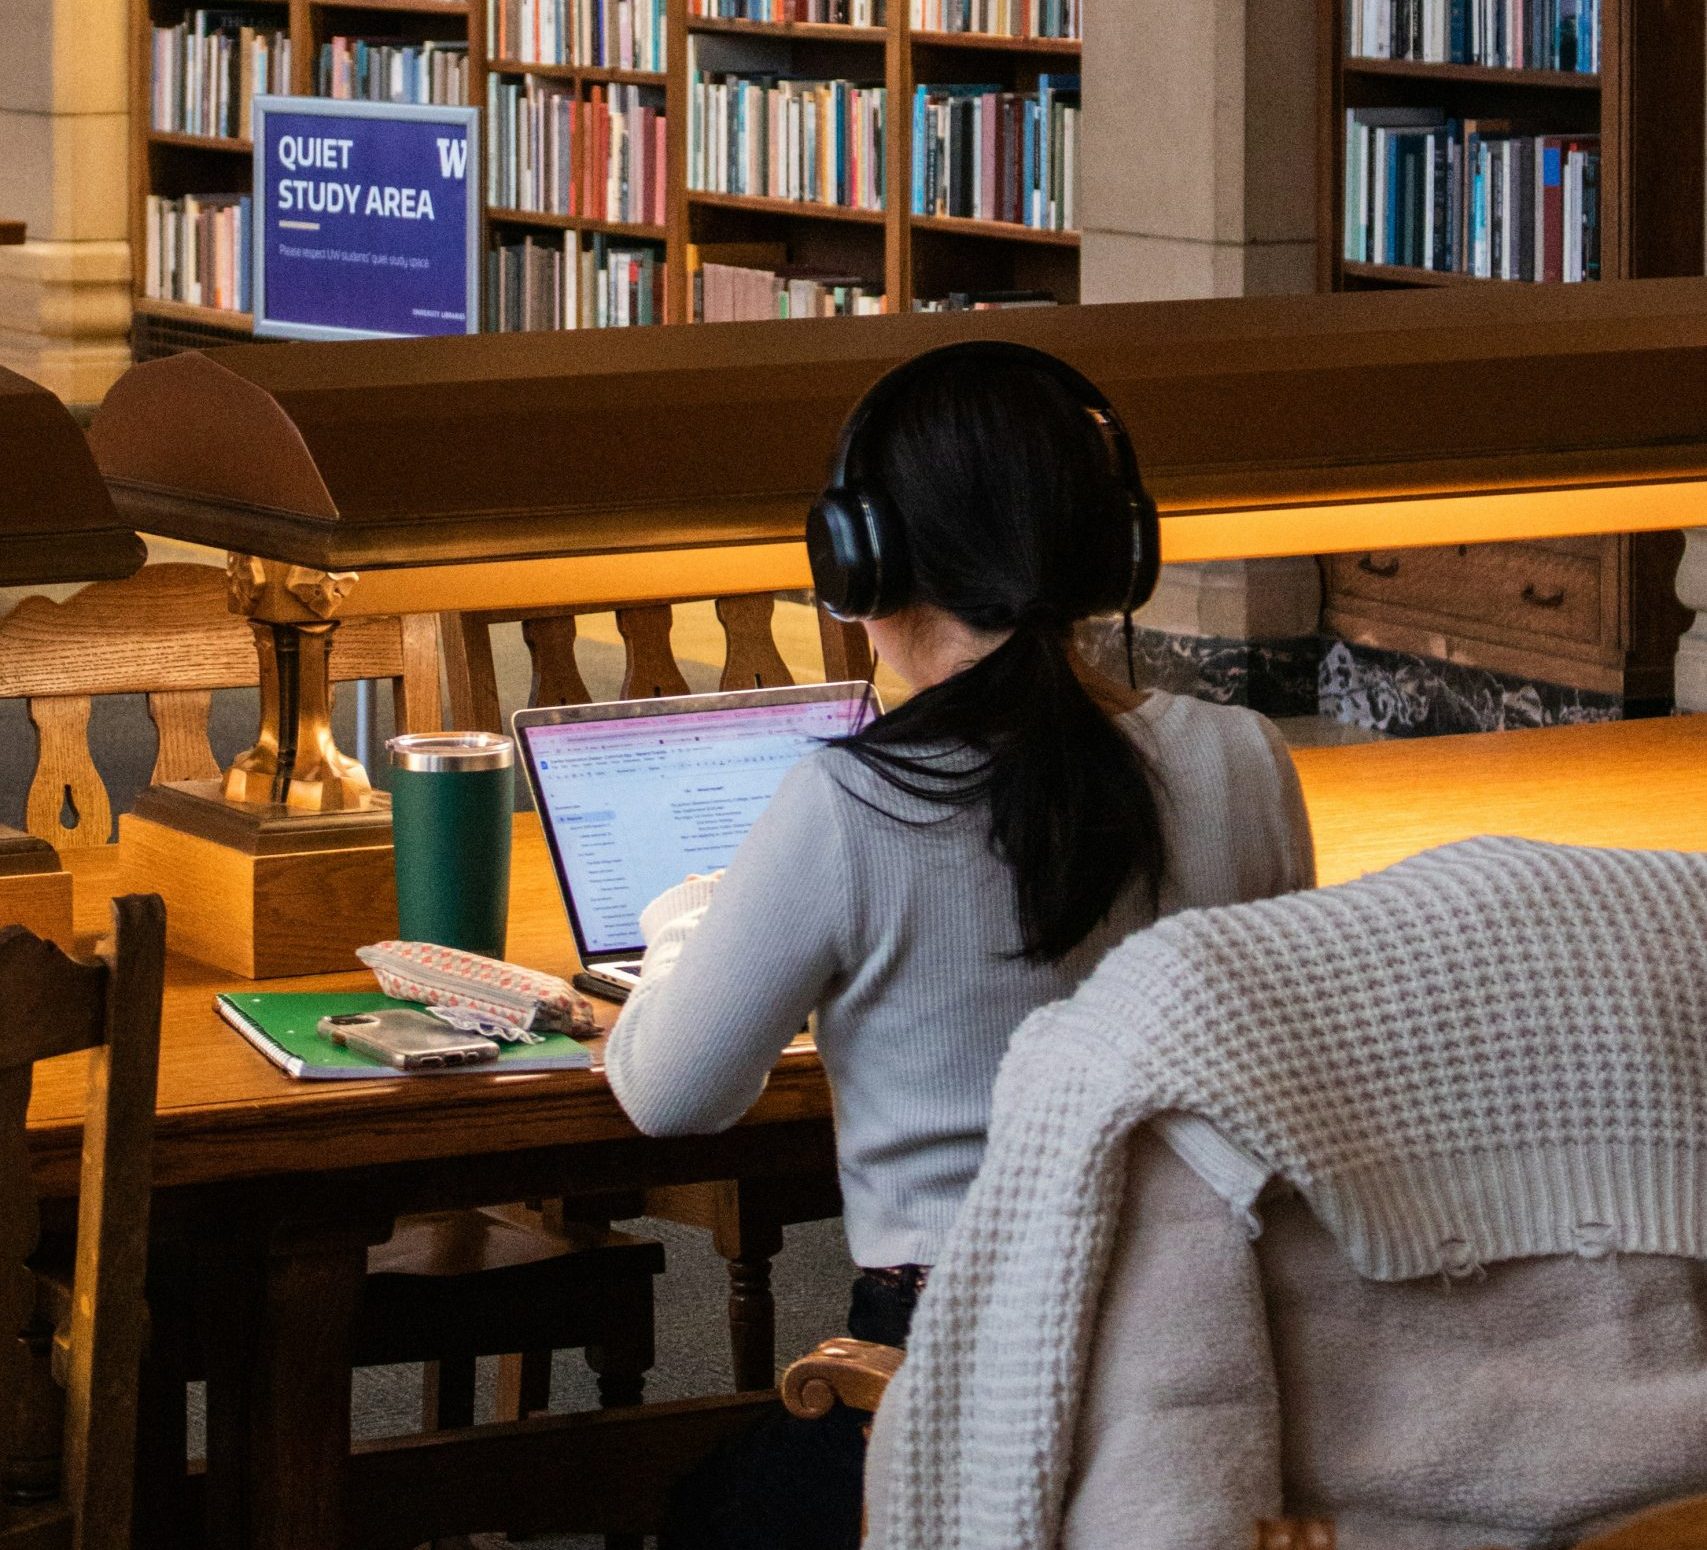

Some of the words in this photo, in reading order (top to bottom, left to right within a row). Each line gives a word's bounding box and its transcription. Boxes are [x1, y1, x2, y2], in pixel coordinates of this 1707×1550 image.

[279, 136, 353, 171] QUIET
[436, 138, 467, 179] W
[279, 179, 361, 215] STUDY
[364, 185, 435, 220] AREA
[280, 244, 301, 257] Please
